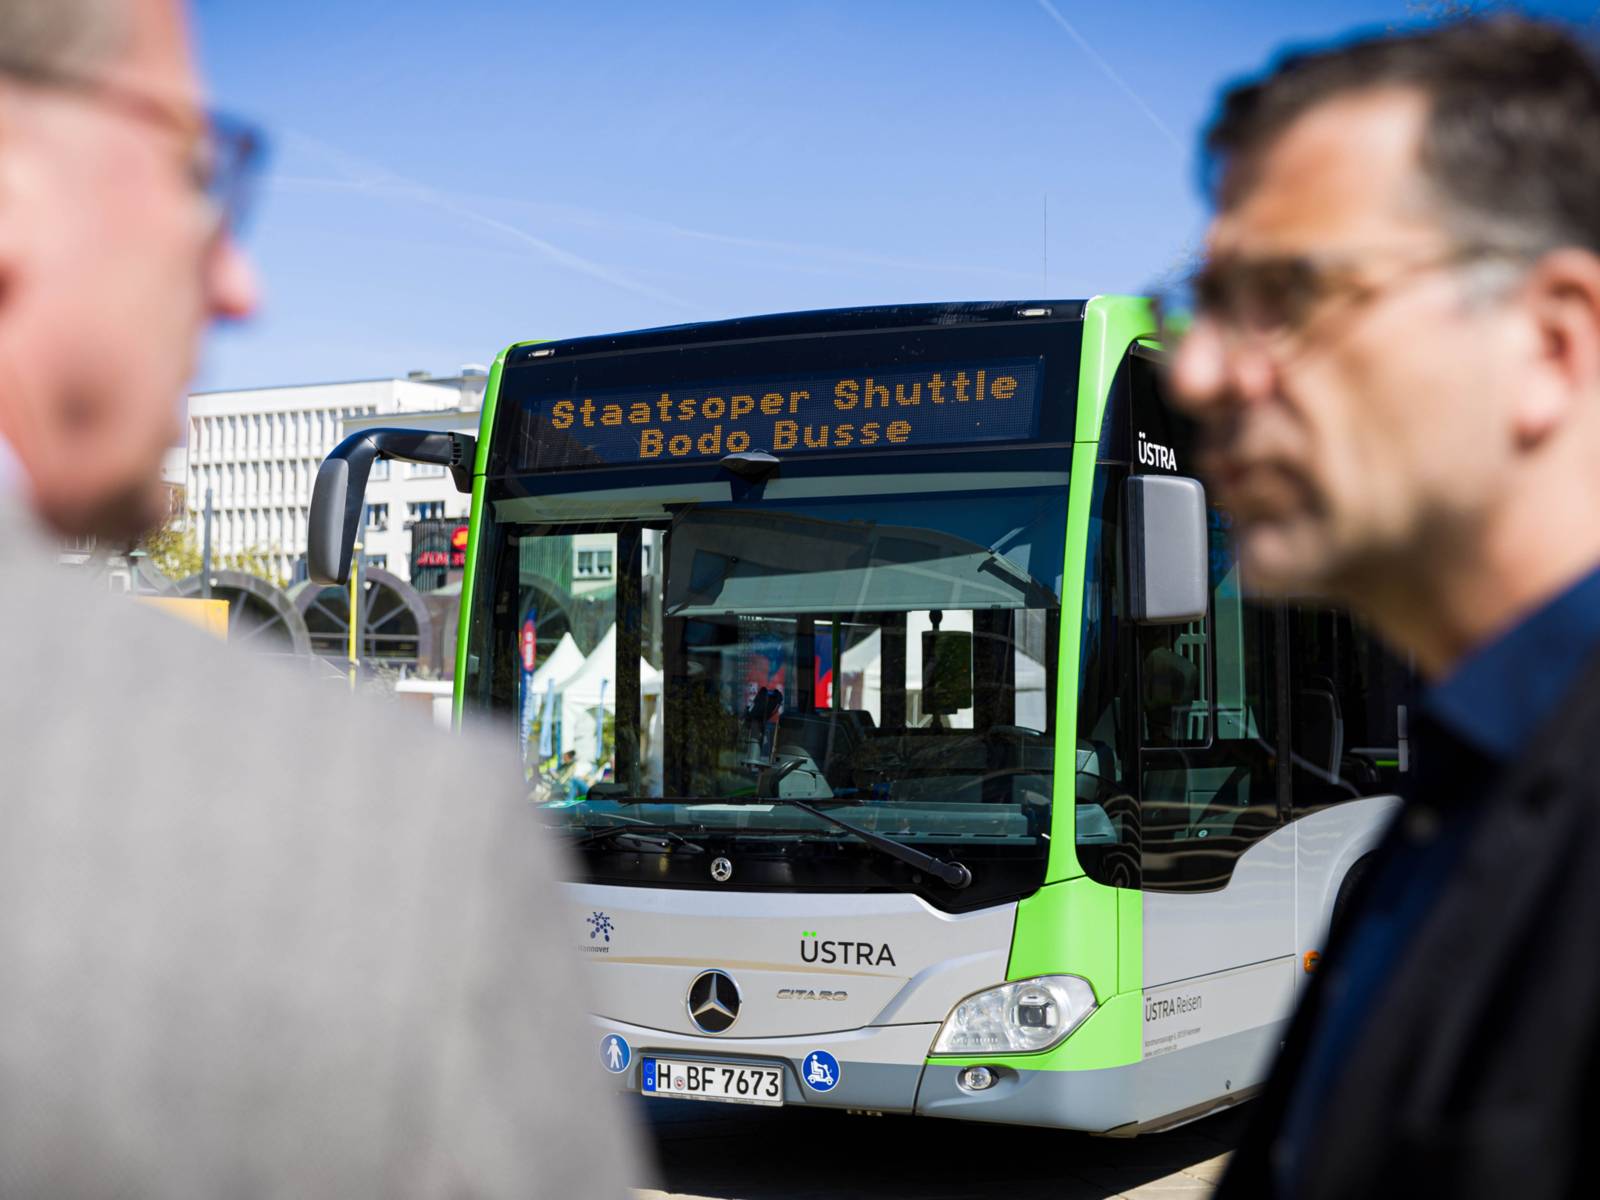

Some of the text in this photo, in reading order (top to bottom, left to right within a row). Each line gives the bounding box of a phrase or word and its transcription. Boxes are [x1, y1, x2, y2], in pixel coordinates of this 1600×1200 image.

[551, 370, 1018, 429] Staatsoper Shuttle
[639, 419, 912, 458] Bodo Busse
[1138, 431, 1177, 471] ÜSTRA
[800, 930, 896, 967] ÜSTRA
[776, 988, 848, 1002] CITARO
[1145, 995, 1202, 1022] ÜSTRA Reisen
[647, 1077, 653, 1086] D
[657, 1064, 779, 1097] H BF 7673
